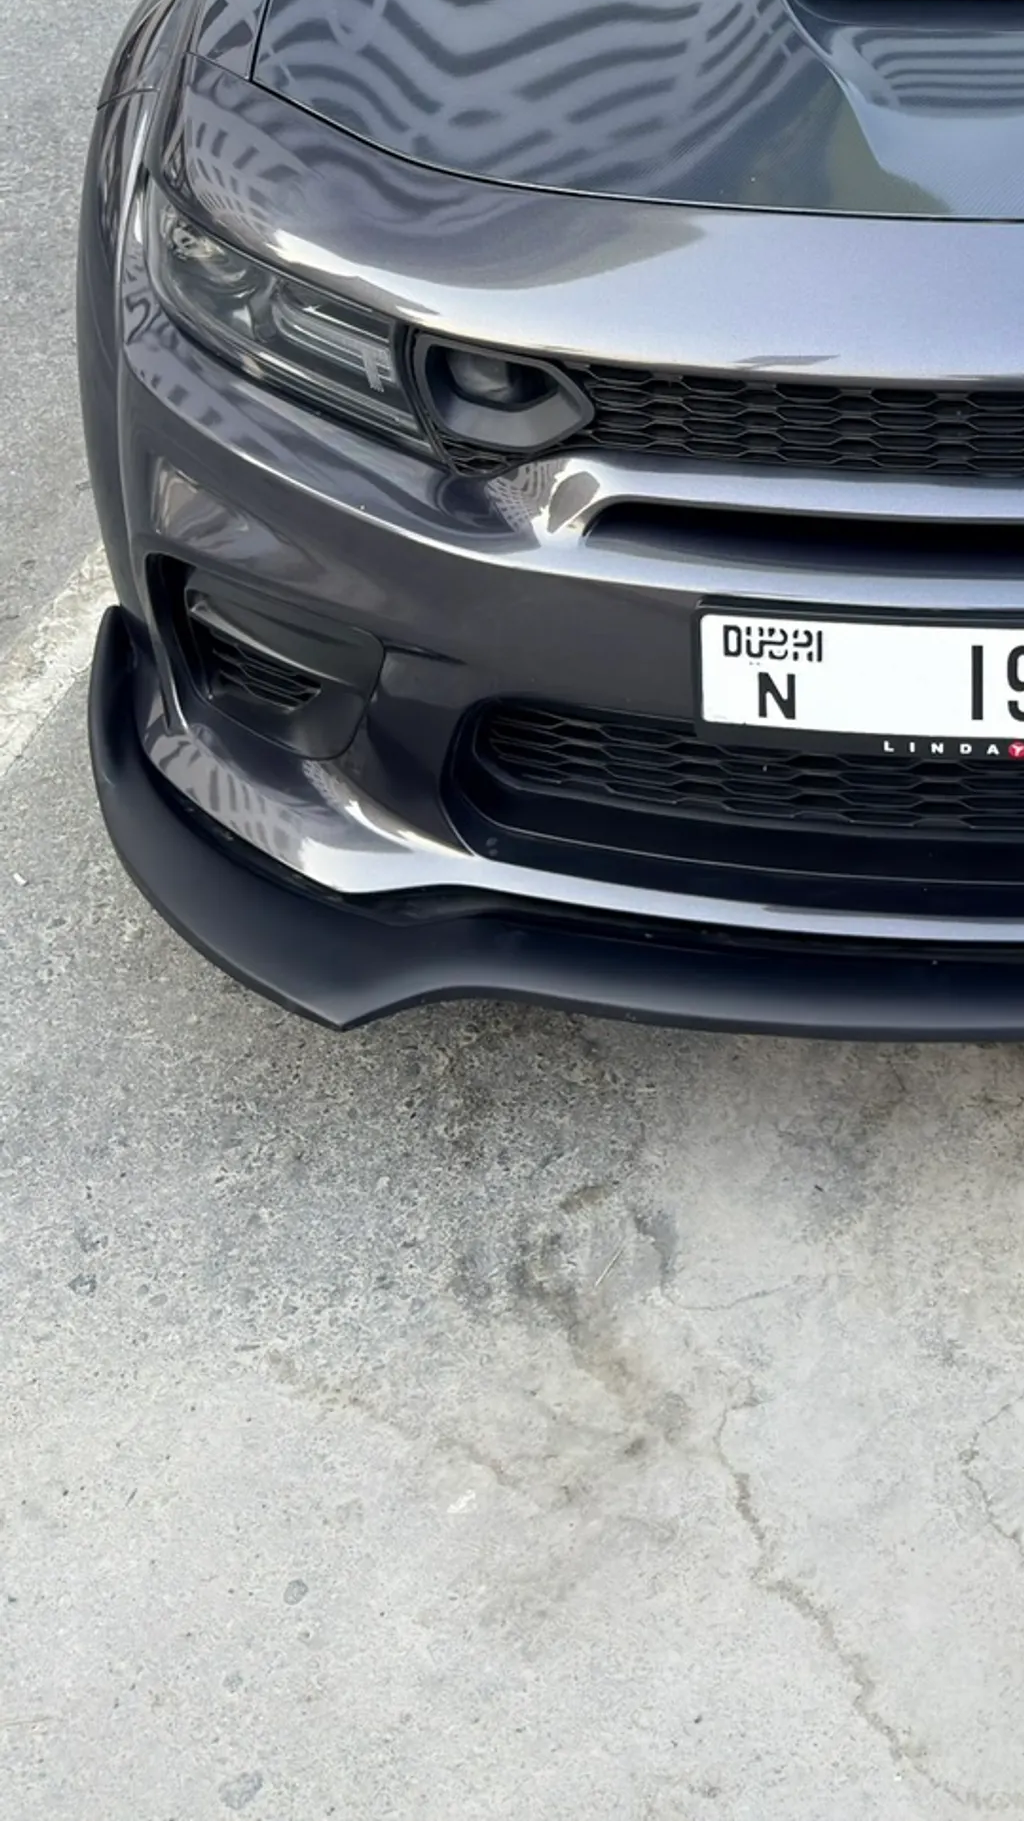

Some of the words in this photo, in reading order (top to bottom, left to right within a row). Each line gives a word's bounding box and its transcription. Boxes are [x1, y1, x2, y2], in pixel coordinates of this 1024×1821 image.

[723, 624, 822, 662] DUBAI
[758, 671, 796, 720] N
[883, 740, 1000, 756] LINDA
